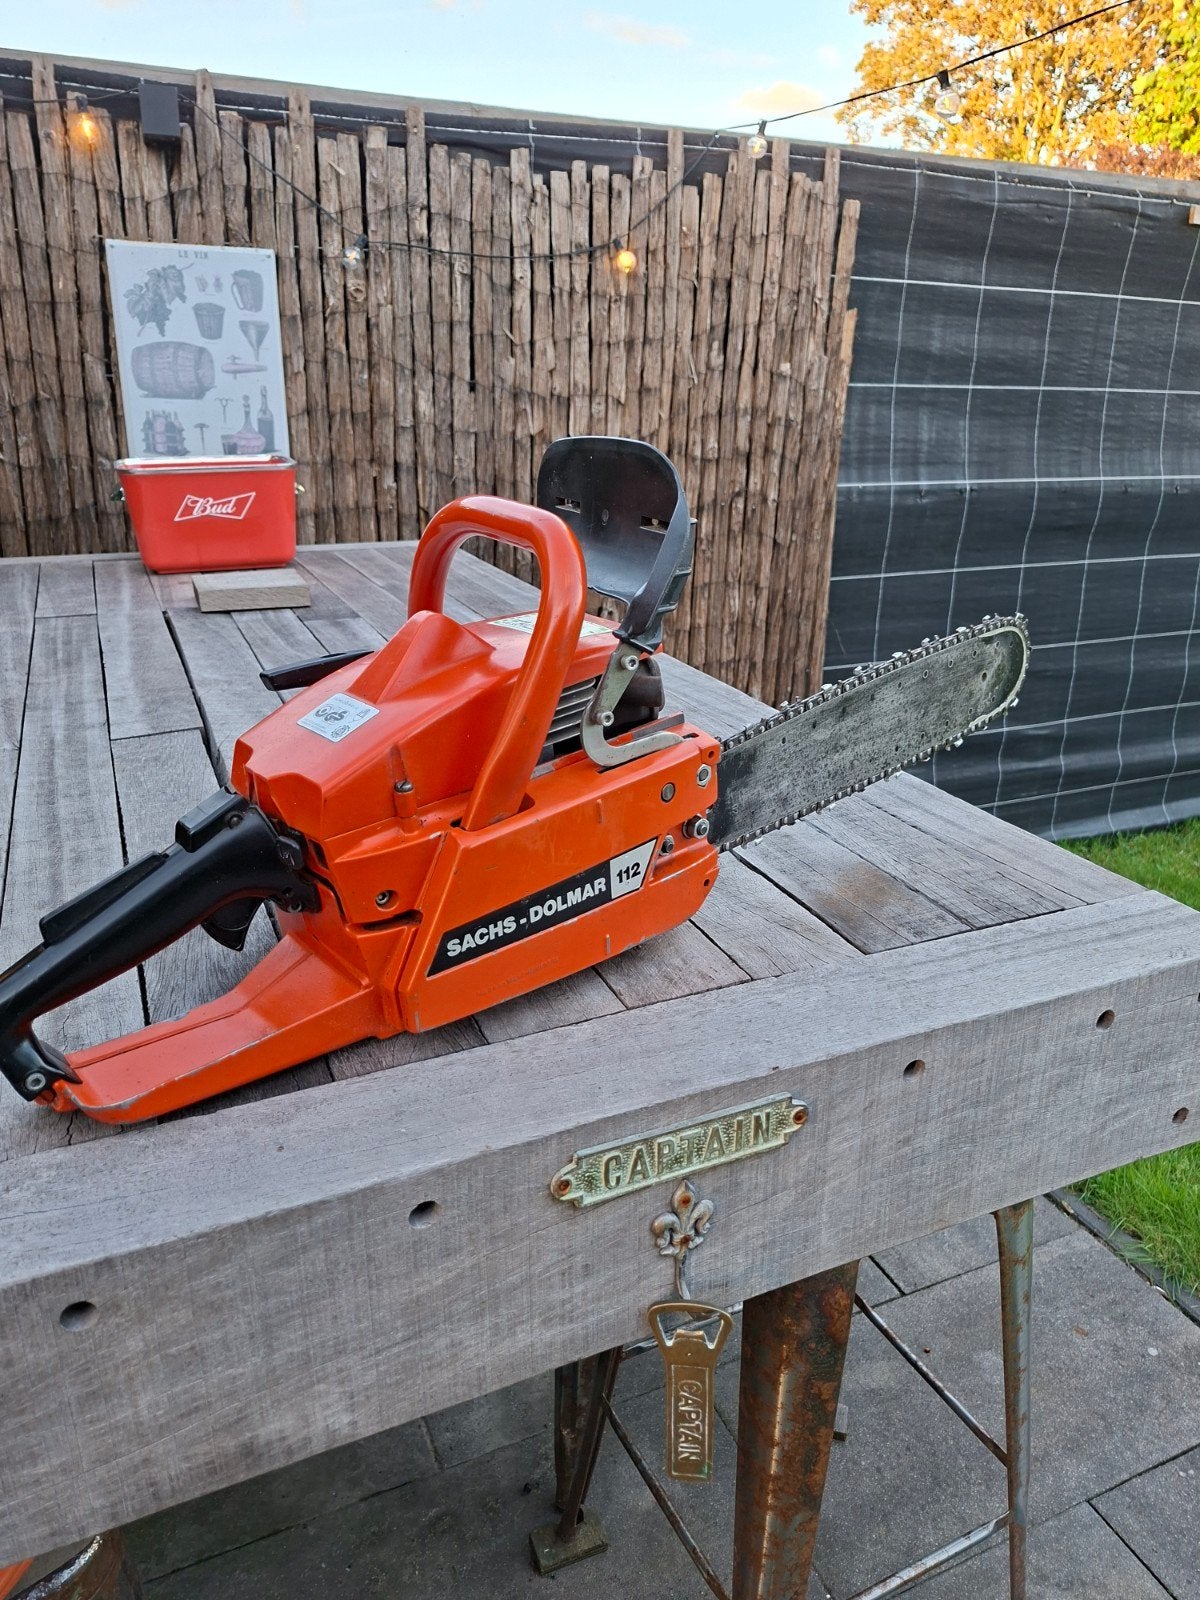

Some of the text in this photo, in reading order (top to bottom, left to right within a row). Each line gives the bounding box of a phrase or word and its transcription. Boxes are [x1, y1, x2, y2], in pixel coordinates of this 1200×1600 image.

[187, 497, 236, 516] Bud
[616, 861, 641, 884] 112
[603, 1111, 772, 1190] CAPTAIN
[678, 1380, 703, 1462] CAPTAIN
